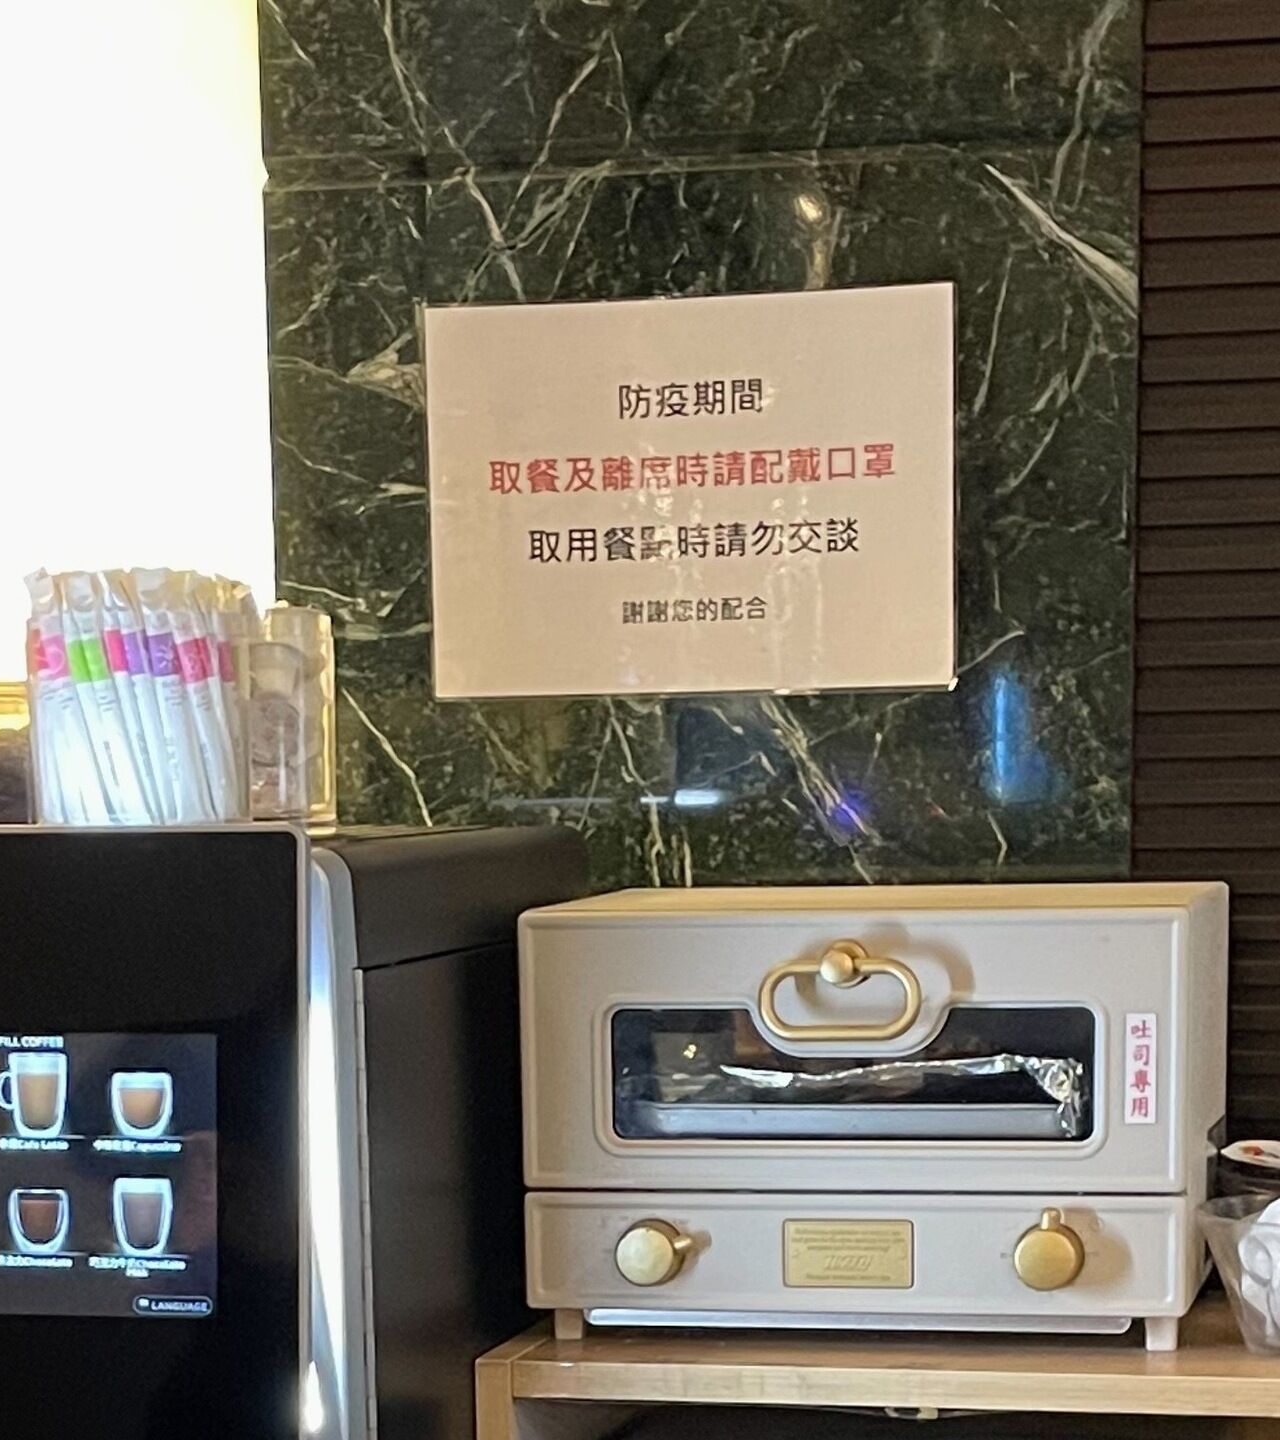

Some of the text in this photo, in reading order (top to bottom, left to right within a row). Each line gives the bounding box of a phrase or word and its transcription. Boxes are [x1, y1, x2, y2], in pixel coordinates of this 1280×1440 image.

[618, 379, 764, 420] 防疫期間
[488, 443, 896, 495] 取餐及離席時請配戴口罩
[528, 517, 860, 563] 取用餐點時請勿交談
[622, 596, 767, 624] 謝謝您的配合
[1130, 1019, 1152, 1118] 吐司專用
[151, 1301, 208, 1312] LANGUAGE
